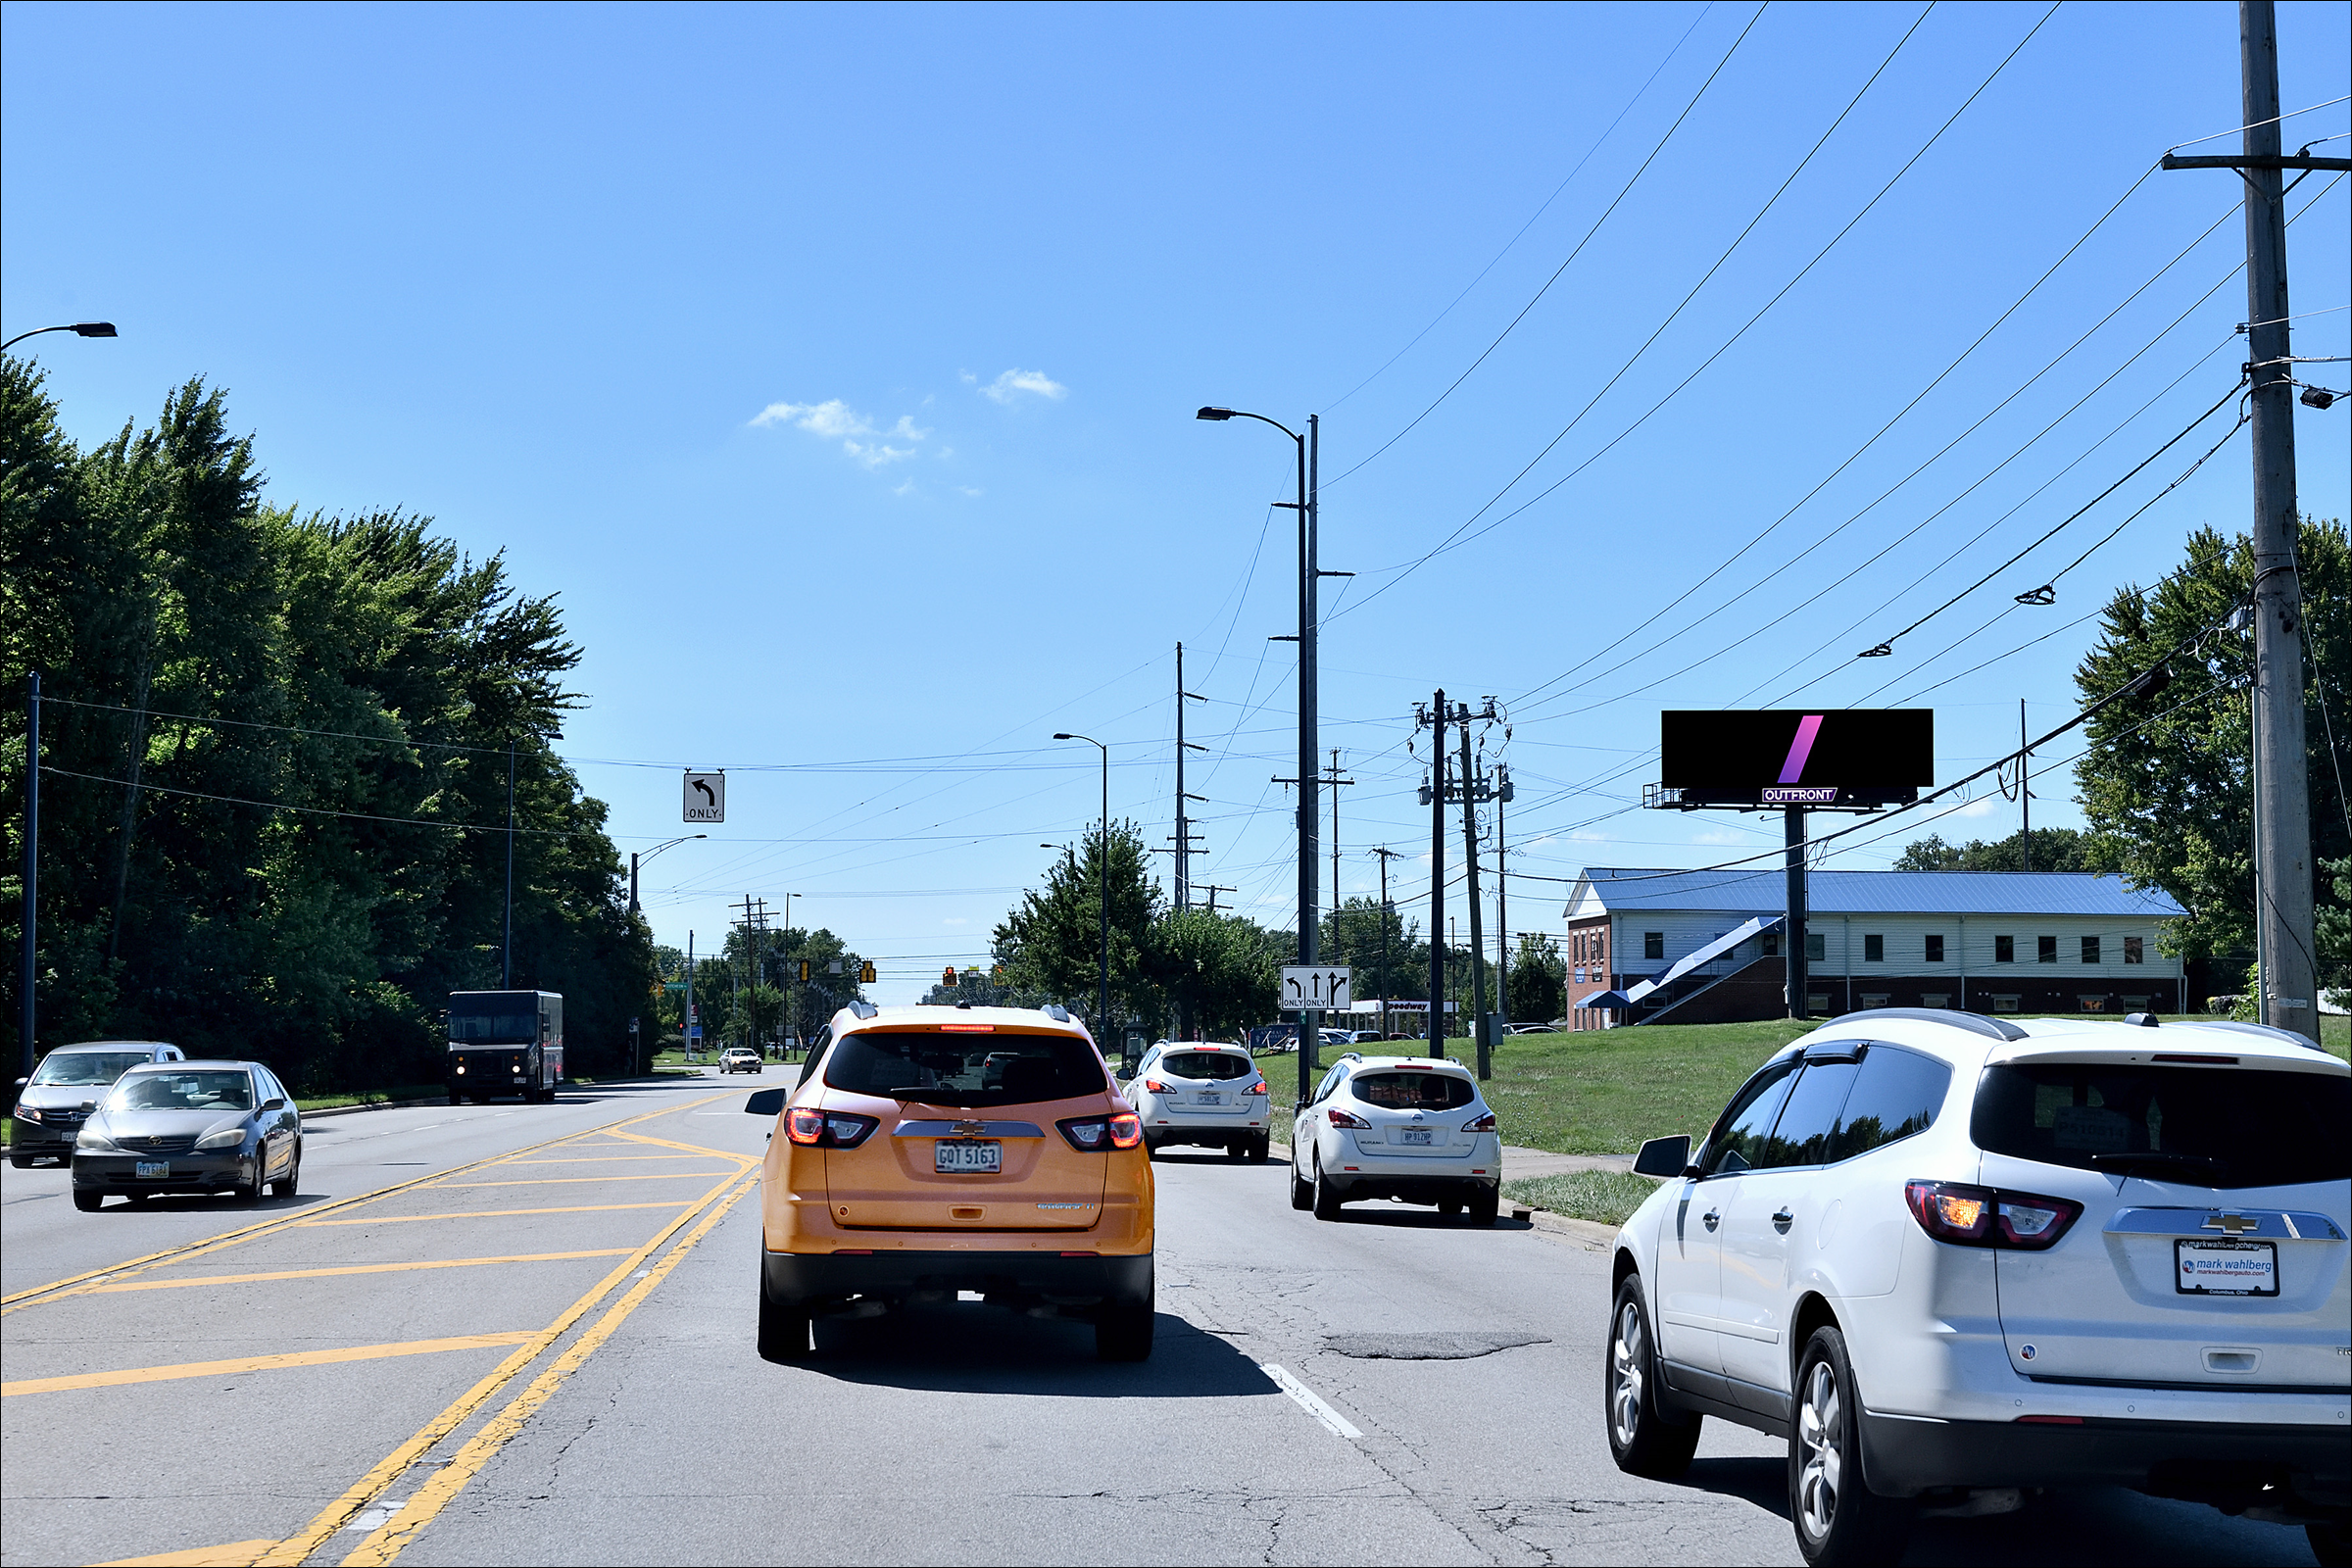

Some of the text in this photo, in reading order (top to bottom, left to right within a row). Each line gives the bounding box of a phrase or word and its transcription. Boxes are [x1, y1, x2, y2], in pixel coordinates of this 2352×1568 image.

[1765, 789, 1834, 801] OUTFRONT
[689, 808, 719, 818] ONLY
[1388, 1002, 1427, 1011] peedway
[965, 1149, 996, 1164] 5163
[2196, 1258, 2272, 1273] mark wahlberg
